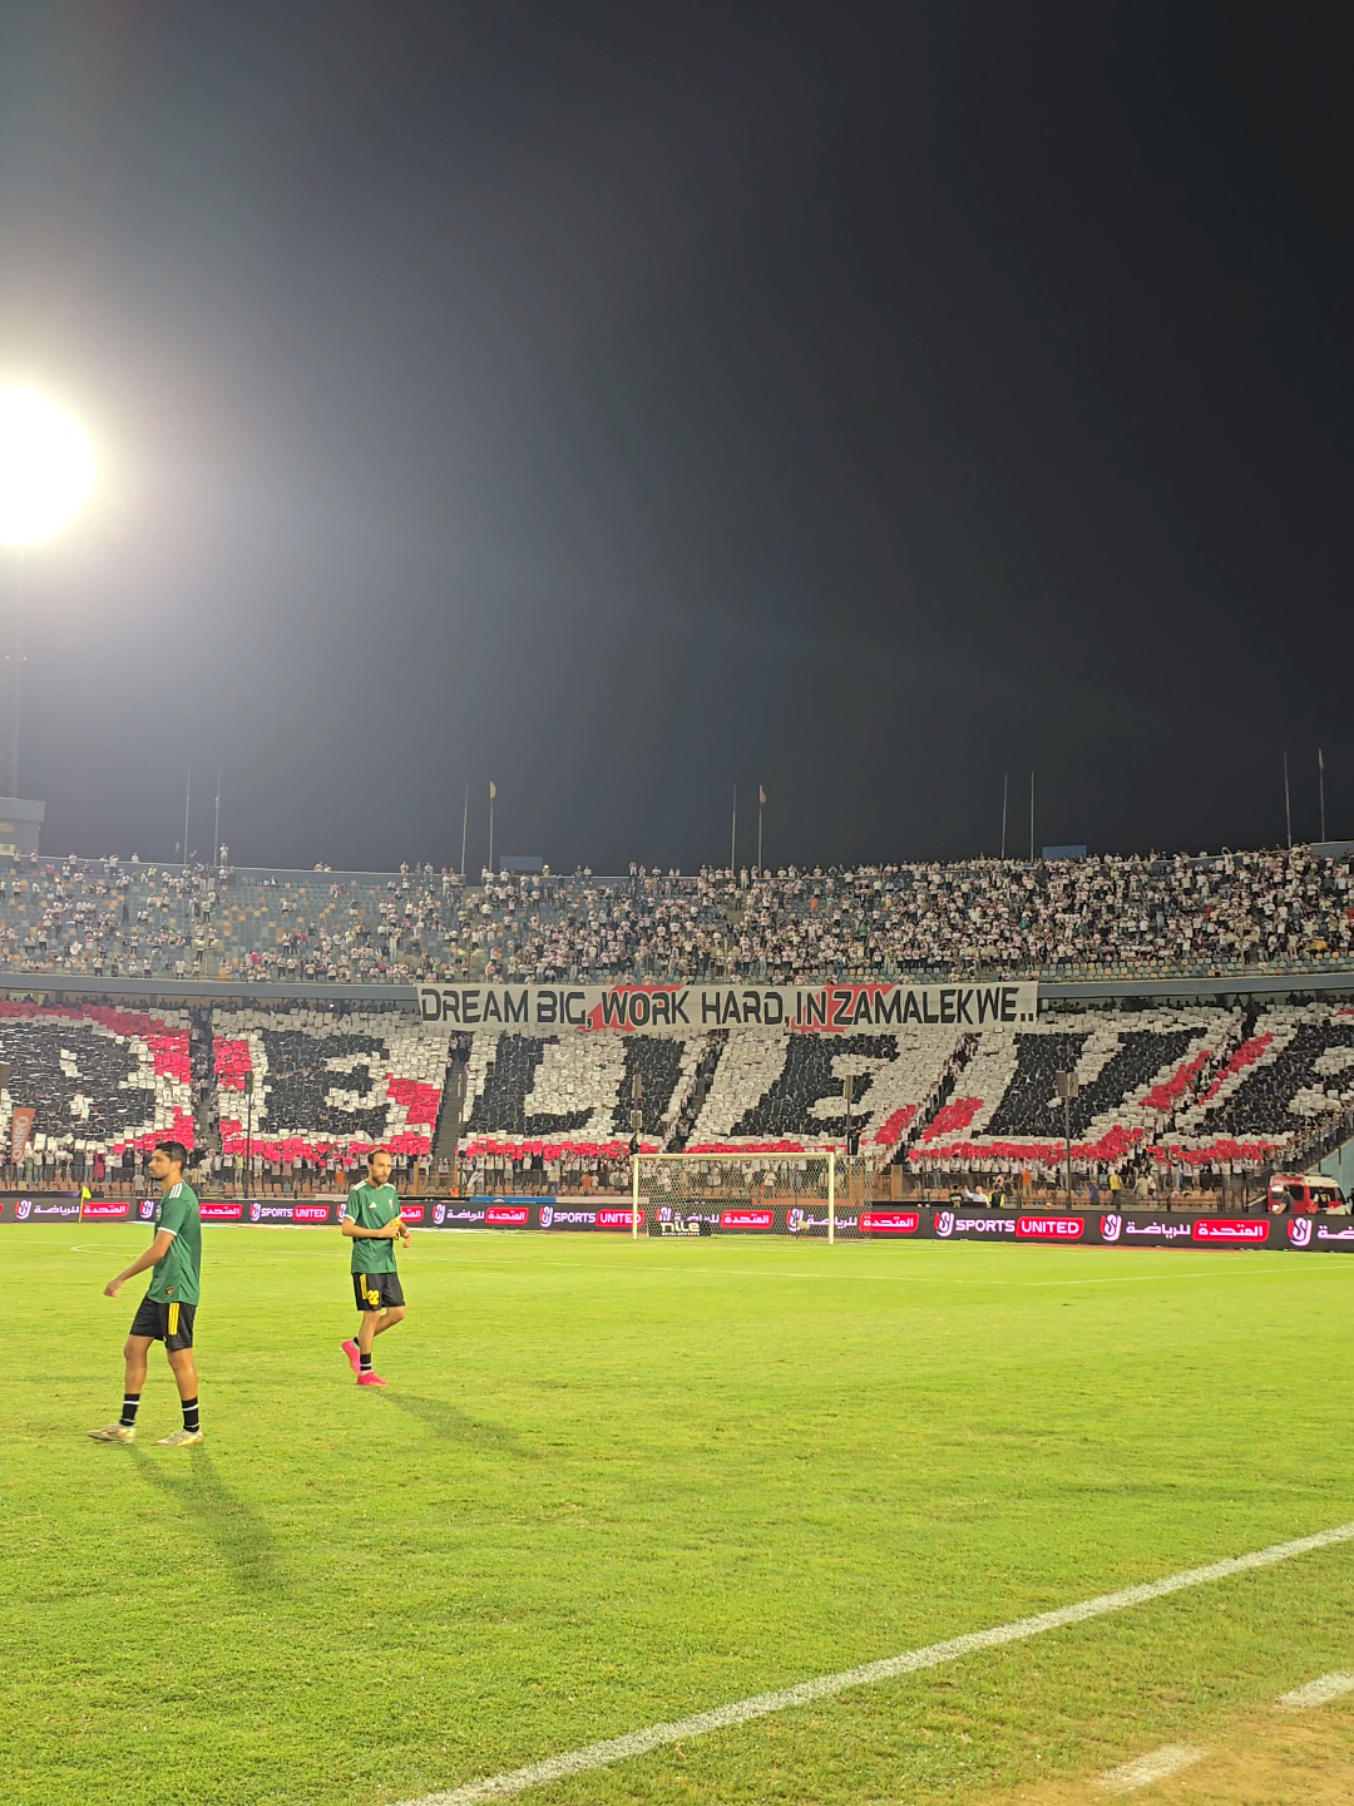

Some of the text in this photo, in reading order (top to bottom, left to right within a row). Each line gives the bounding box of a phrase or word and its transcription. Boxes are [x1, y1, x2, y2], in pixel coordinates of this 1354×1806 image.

[421, 988, 528, 1022] DREAM
[537, 989, 593, 1029] BIG,
[601, 990, 690, 1026] WORK
[702, 990, 790, 1028] HARD,
[796, 991, 827, 1025] IN
[12, 1115, 30, 1160] ONIRO
[33, 1204, 80, 1216] للرياضة
[83, 1205, 126, 1215] المتحدة
[261, 1207, 293, 1218] SPORTS
[295, 1208, 327, 1218] UNITED
[447, 1209, 485, 1222] للرياضة
[488, 1210, 525, 1220] المتحدة
[554, 1212, 596, 1223] SPORTS
[863, 1214, 914, 1227] المتحدة
[955, 1219, 1015, 1232] SPORTS
[1021, 1220, 1079, 1234] UNITED
[1125, 1221, 1191, 1239] للرياضة
[1198, 1222, 1263, 1237] المتحدة
